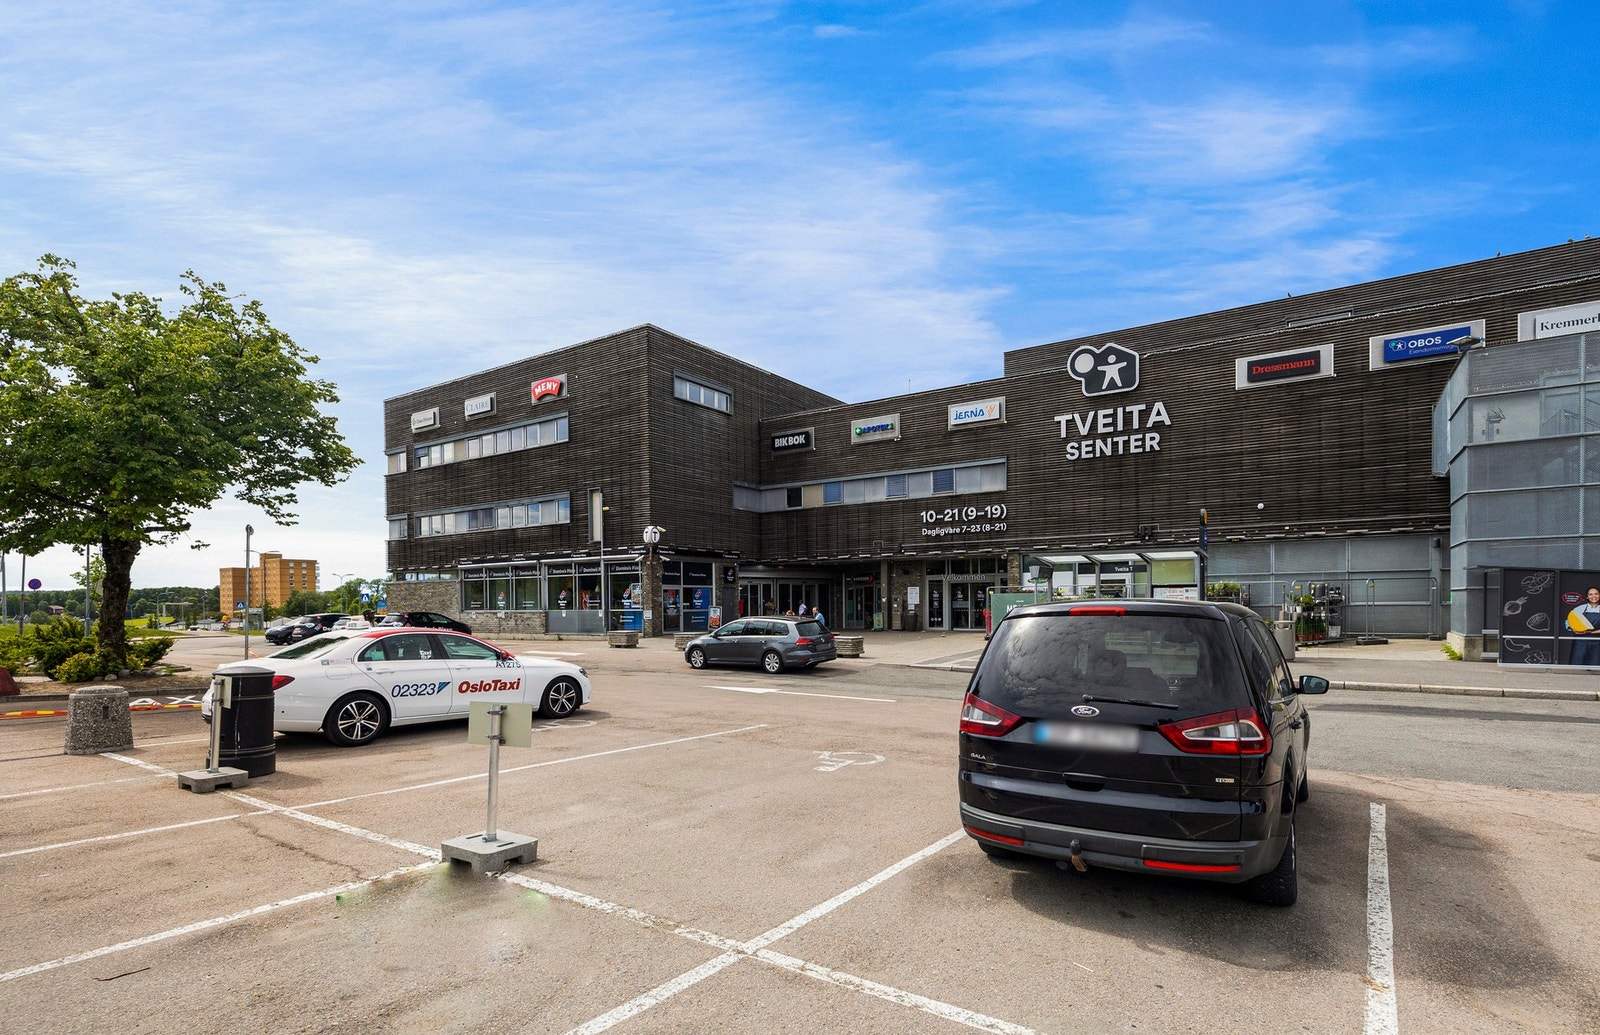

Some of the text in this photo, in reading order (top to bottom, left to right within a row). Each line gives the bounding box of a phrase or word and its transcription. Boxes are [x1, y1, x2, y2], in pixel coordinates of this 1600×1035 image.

[1540, 313, 1600, 332] Kremmer
[1408, 336, 1442, 348] OBOS
[1252, 358, 1316, 375] Dressmann
[534, 381, 558, 396] MENY
[465, 400, 490, 413] CLAIRE
[1054, 401, 1172, 438] TVEITA
[1065, 432, 1161, 461] SENTER
[920, 504, 1008, 523] 10-21 (9-19)
[921, 522, 1007, 537] Dagligvare 7-23 (8-21)
[391, 684, 436, 698] 02323
[458, 678, 520, 694] OsloTaxi
